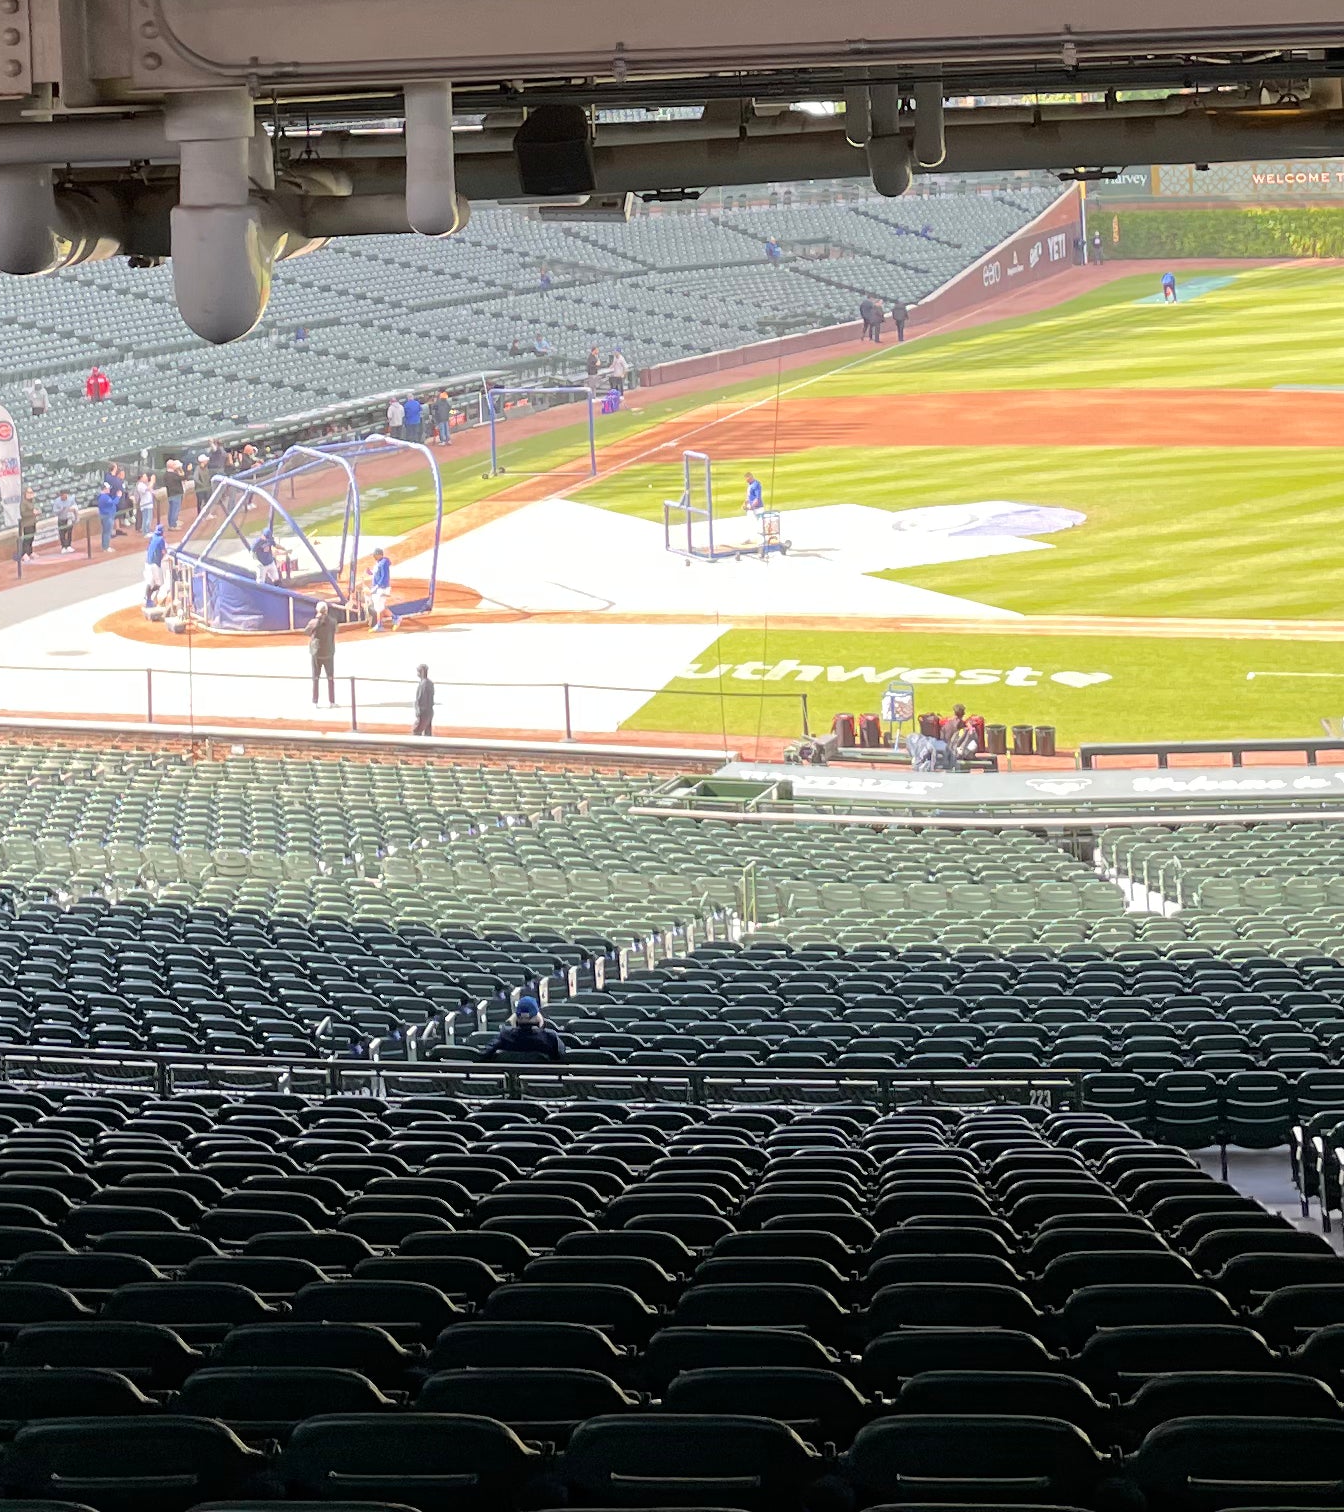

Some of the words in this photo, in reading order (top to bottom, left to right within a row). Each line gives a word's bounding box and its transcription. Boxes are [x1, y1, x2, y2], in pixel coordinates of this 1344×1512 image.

[1252, 172, 1331, 184] WELCOME
[1047, 232, 1066, 262] YETI
[676, 659, 1044, 686] uthwest
